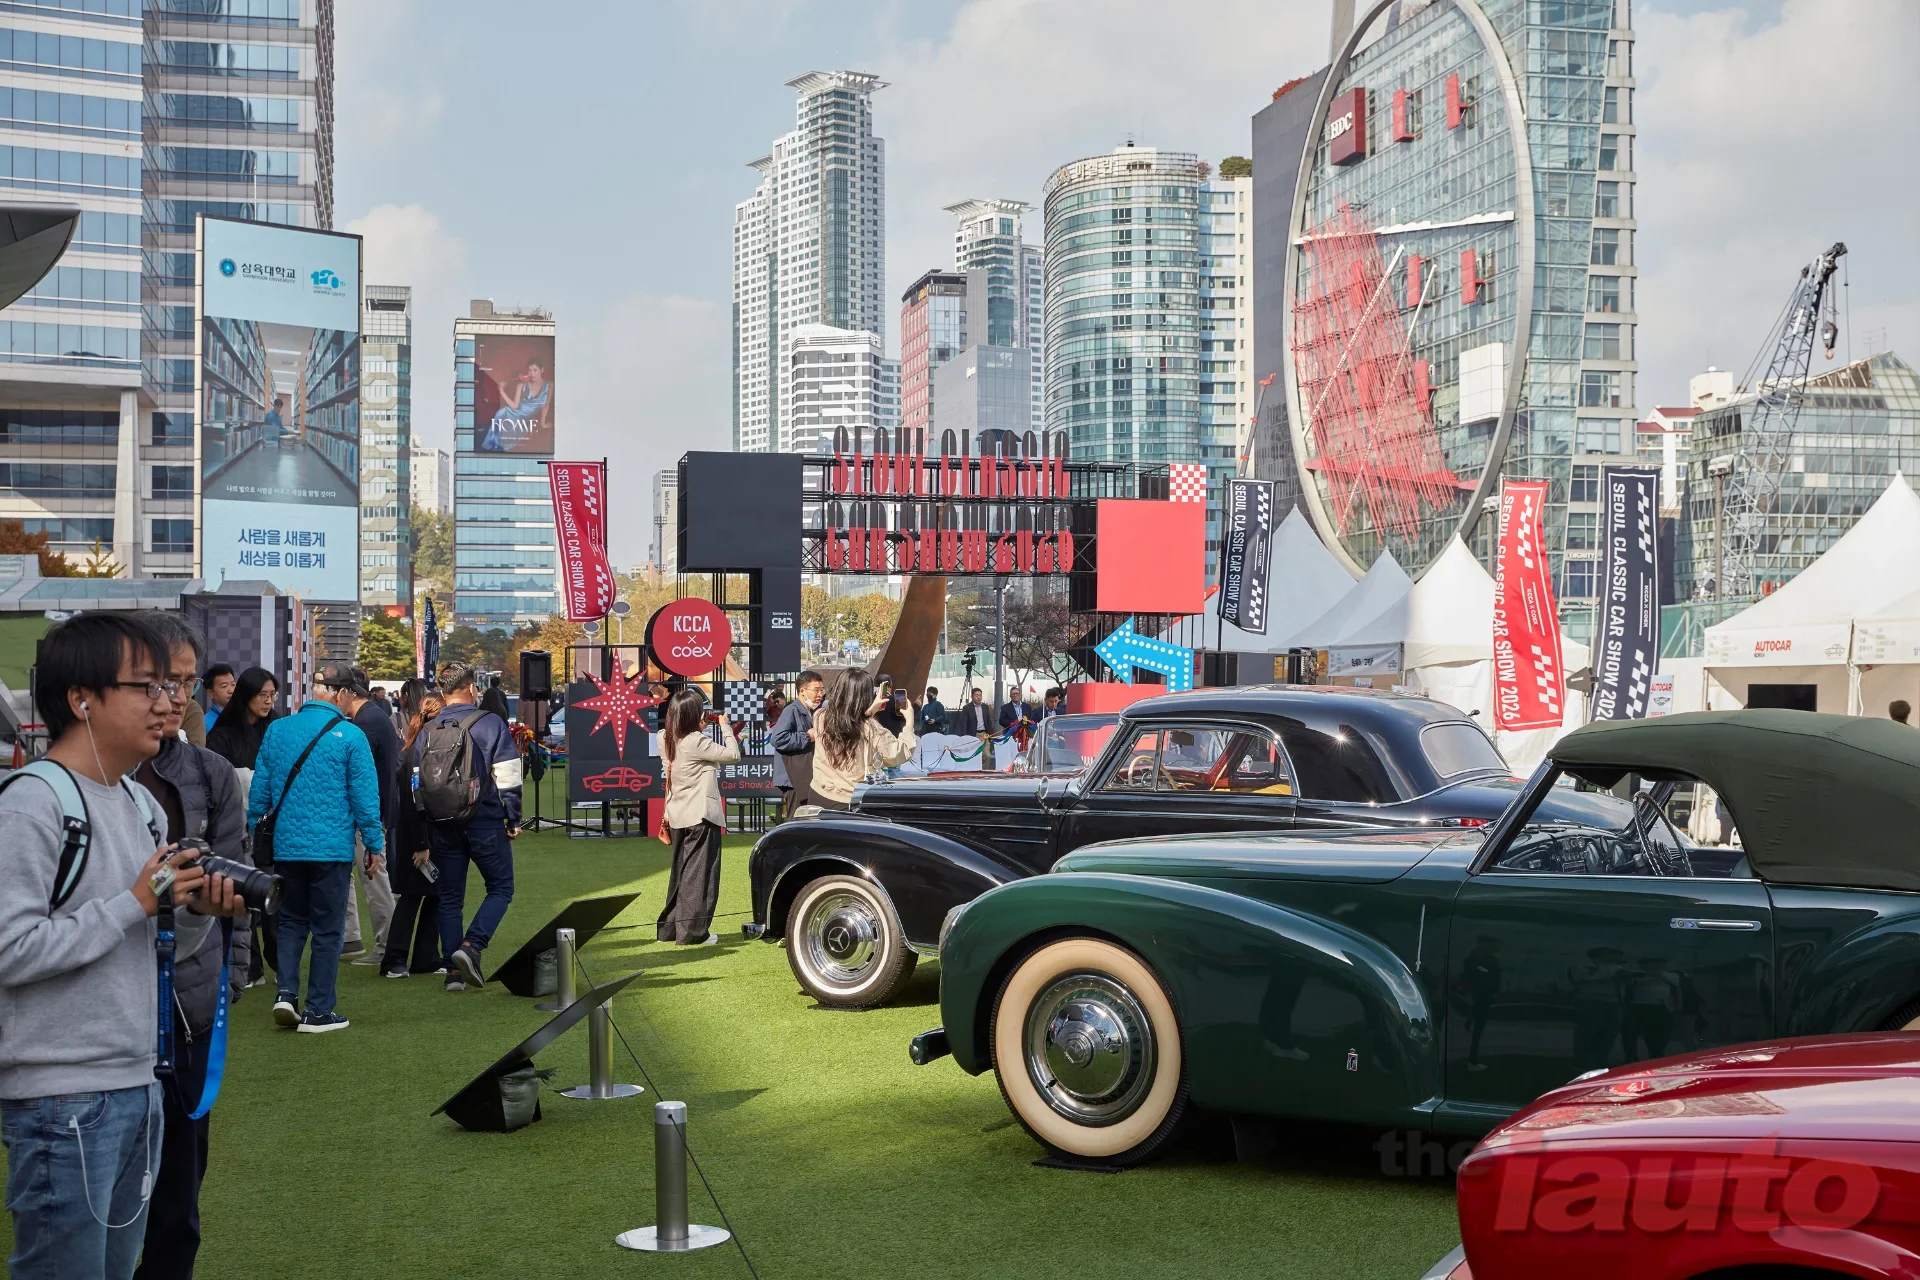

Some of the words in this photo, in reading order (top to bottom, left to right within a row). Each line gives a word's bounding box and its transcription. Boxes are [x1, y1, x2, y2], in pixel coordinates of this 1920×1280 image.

[1330, 112, 1353, 140] HDC
[241, 263, 296, 279] 삼육대학교
[491, 418, 538, 433] HOME
[833, 425, 929, 496] SEOUL
[940, 428, 1071, 500] CLASSIC
[557, 468, 571, 498] SEOUL
[1234, 484, 1247, 512] SEOUL
[1613, 482, 1626, 532] SEOUL
[562, 500, 579, 538] CLASSIC
[1500, 495, 1515, 540] SEOUL
[238, 527, 281, 546] 사람을
[284, 530, 325, 548] 새롭게
[827, 500, 887, 571] CAR
[899, 503, 987, 573] SHOW
[1232, 514, 1247, 552] CLASSIC
[238, 550, 281, 568] 세상을
[284, 552, 325, 569] 이롭게
[568, 538, 581, 559] CAR
[1229, 553, 1243, 573] CAR
[570, 560, 586, 590] SHOW
[1612, 537, 1627, 602] CLASSIC
[1228, 574, 1241, 601] SHOW
[574, 591, 587, 616] 2026
[673, 615, 711, 633] KCCA
[1494, 607, 1509, 637] CAR
[1608, 605, 1626, 638] CAR
[671, 642, 713, 658] coex
[1755, 640, 1792, 652] AUTOCAR
[1495, 640, 1517, 682] SHOW
[1604, 640, 1624, 687] SHOW
[1501, 686, 1521, 721] 2026
[721, 781, 737, 790] Car
[738, 780, 763, 789] Show
